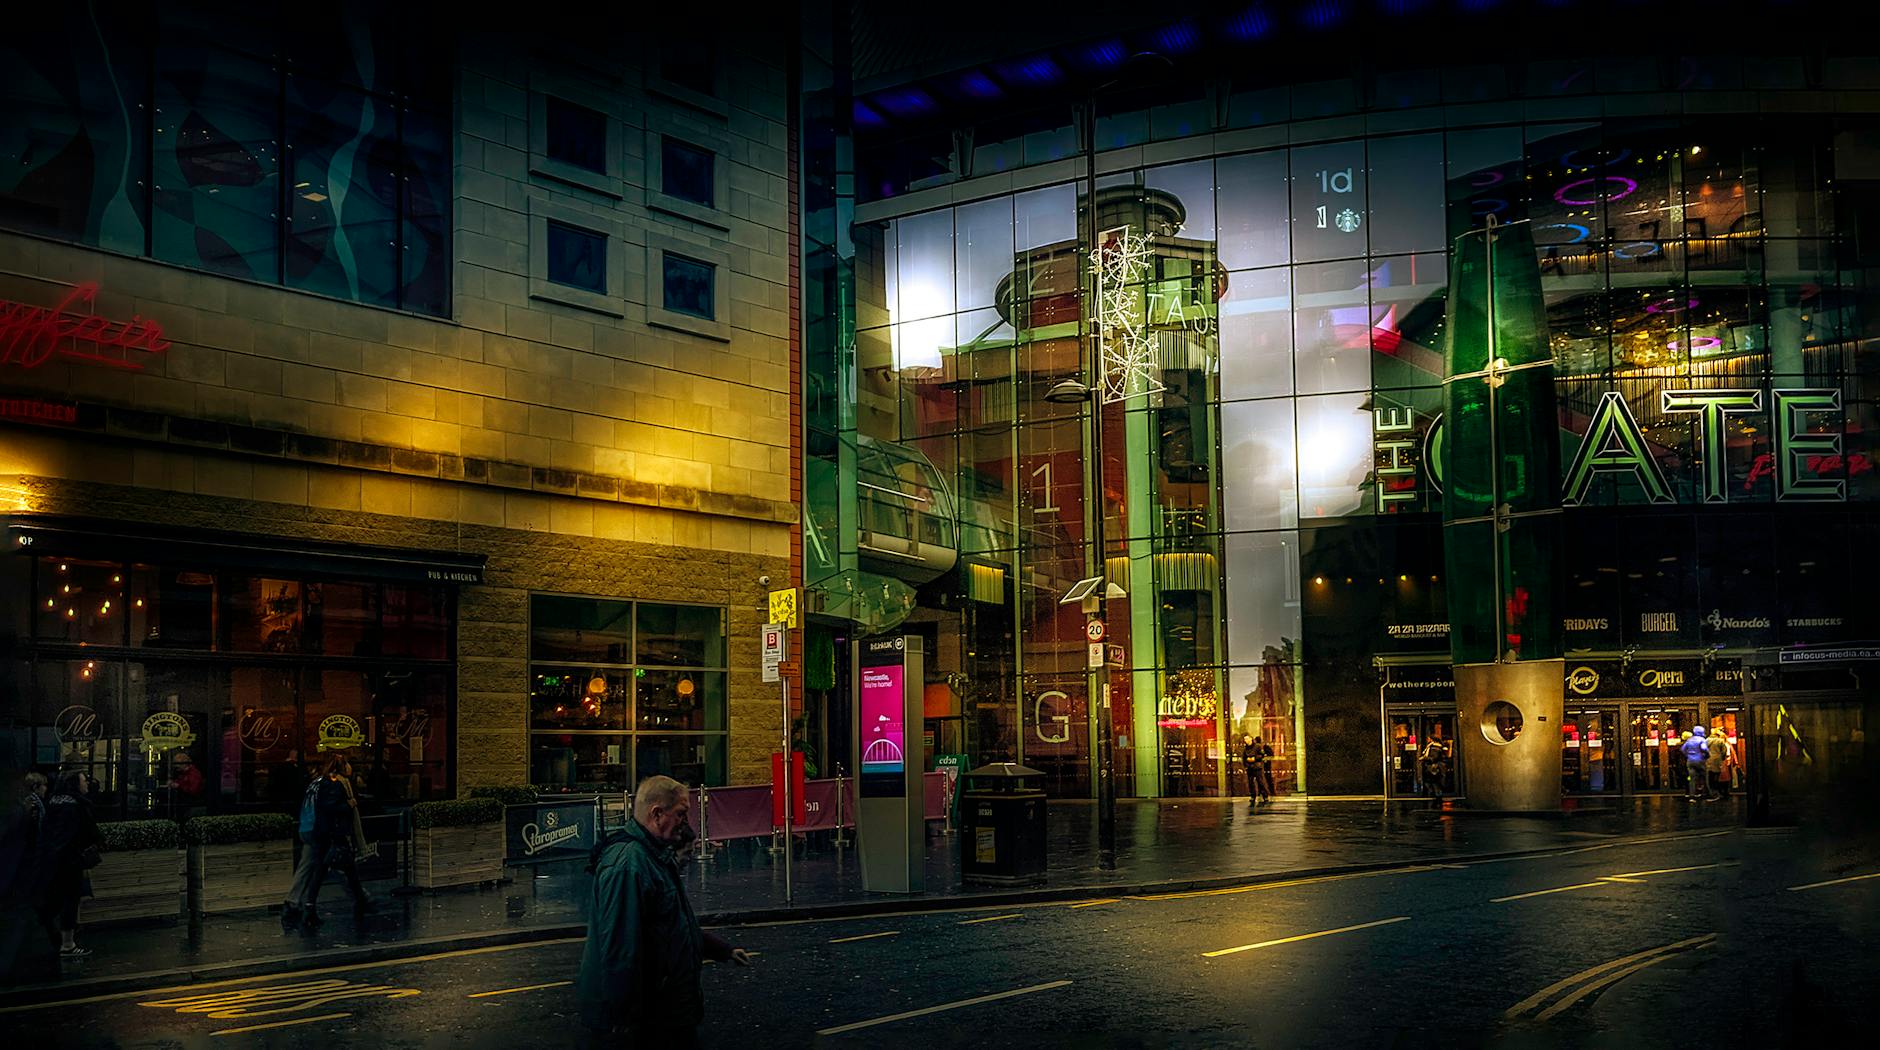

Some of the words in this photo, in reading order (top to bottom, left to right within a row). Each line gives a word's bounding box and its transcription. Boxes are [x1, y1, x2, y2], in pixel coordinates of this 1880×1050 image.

[1374, 405, 1418, 514] THE
[1032, 462, 1061, 514] 1
[1722, 617, 1771, 629] Nando's
[1786, 617, 1843, 627] STARBUCKS
[1089, 625, 1102, 635] 20
[1389, 680, 1456, 690] wetherspoon
[1639, 669, 1685, 688] Opera
[1035, 690, 1070, 743] G
